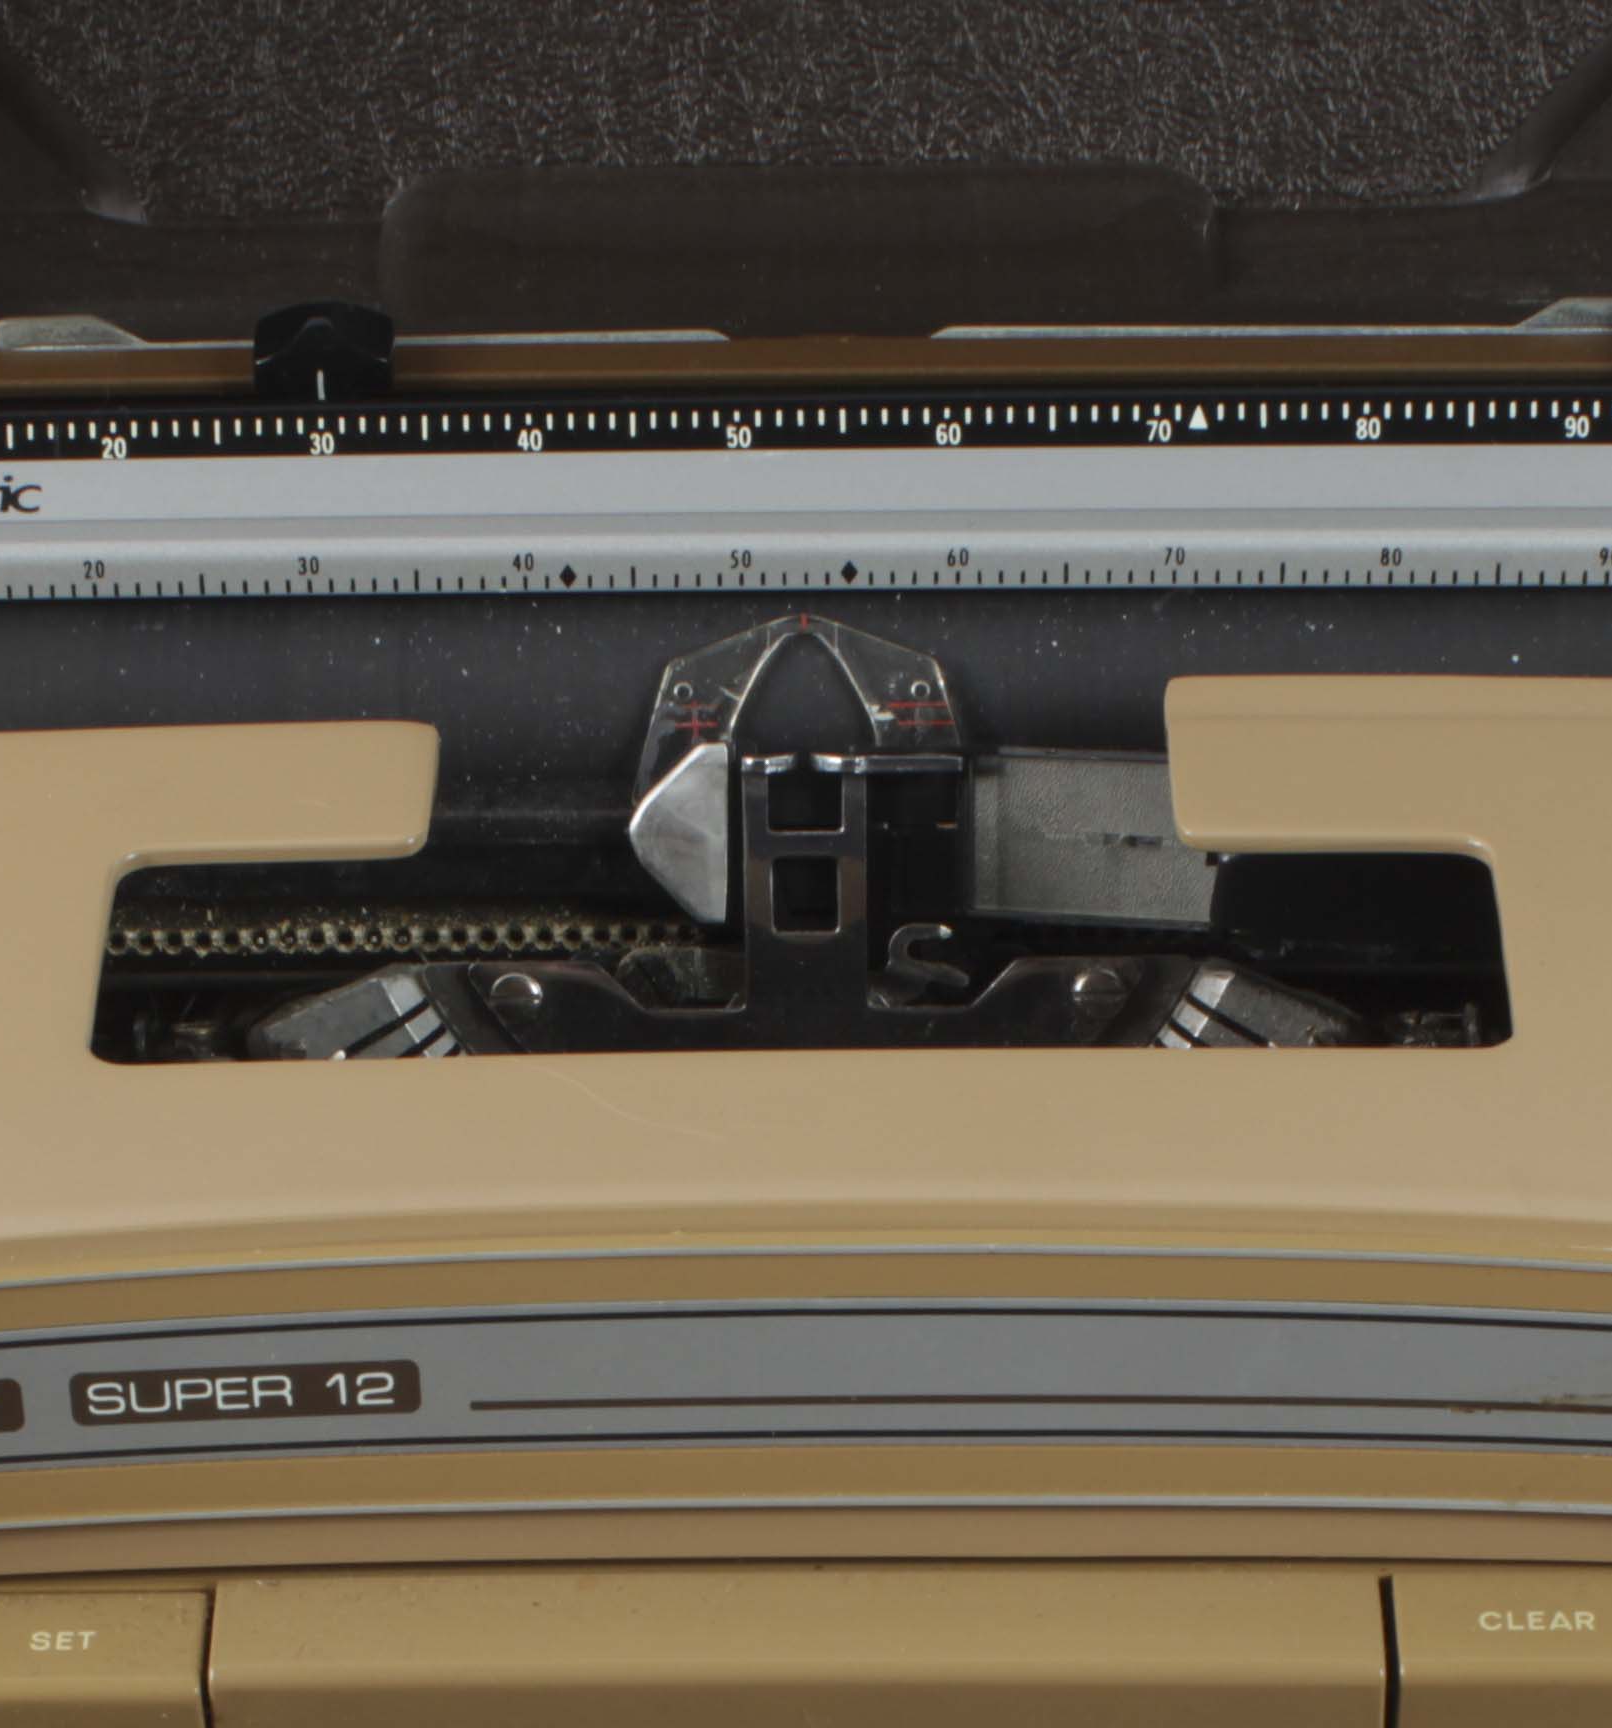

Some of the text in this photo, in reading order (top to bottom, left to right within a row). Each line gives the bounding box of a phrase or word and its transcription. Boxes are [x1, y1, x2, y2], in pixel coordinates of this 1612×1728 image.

[101, 436, 128, 460] 20
[310, 432, 335, 456] 30
[517, 429, 543, 452] 40
[726, 426, 752, 448] 50
[935, 424, 961, 446] 60
[1146, 420, 1172, 442] 70
[1356, 417, 1381, 439] 80
[1564, 416, 1590, 438] 90
[83, 560, 105, 580] 20
[298, 556, 320, 576] 30
[513, 552, 535, 572] 40
[731, 550, 752, 569] 50
[947, 548, 969, 567] 60
[1164, 547, 1185, 567] 70
[1380, 547, 1402, 567] 80
[85, 1372, 396, 1415] SUPER 12
[1478, 1610, 1597, 1632] CLEAR
[29, 1630, 95, 1652] SET
